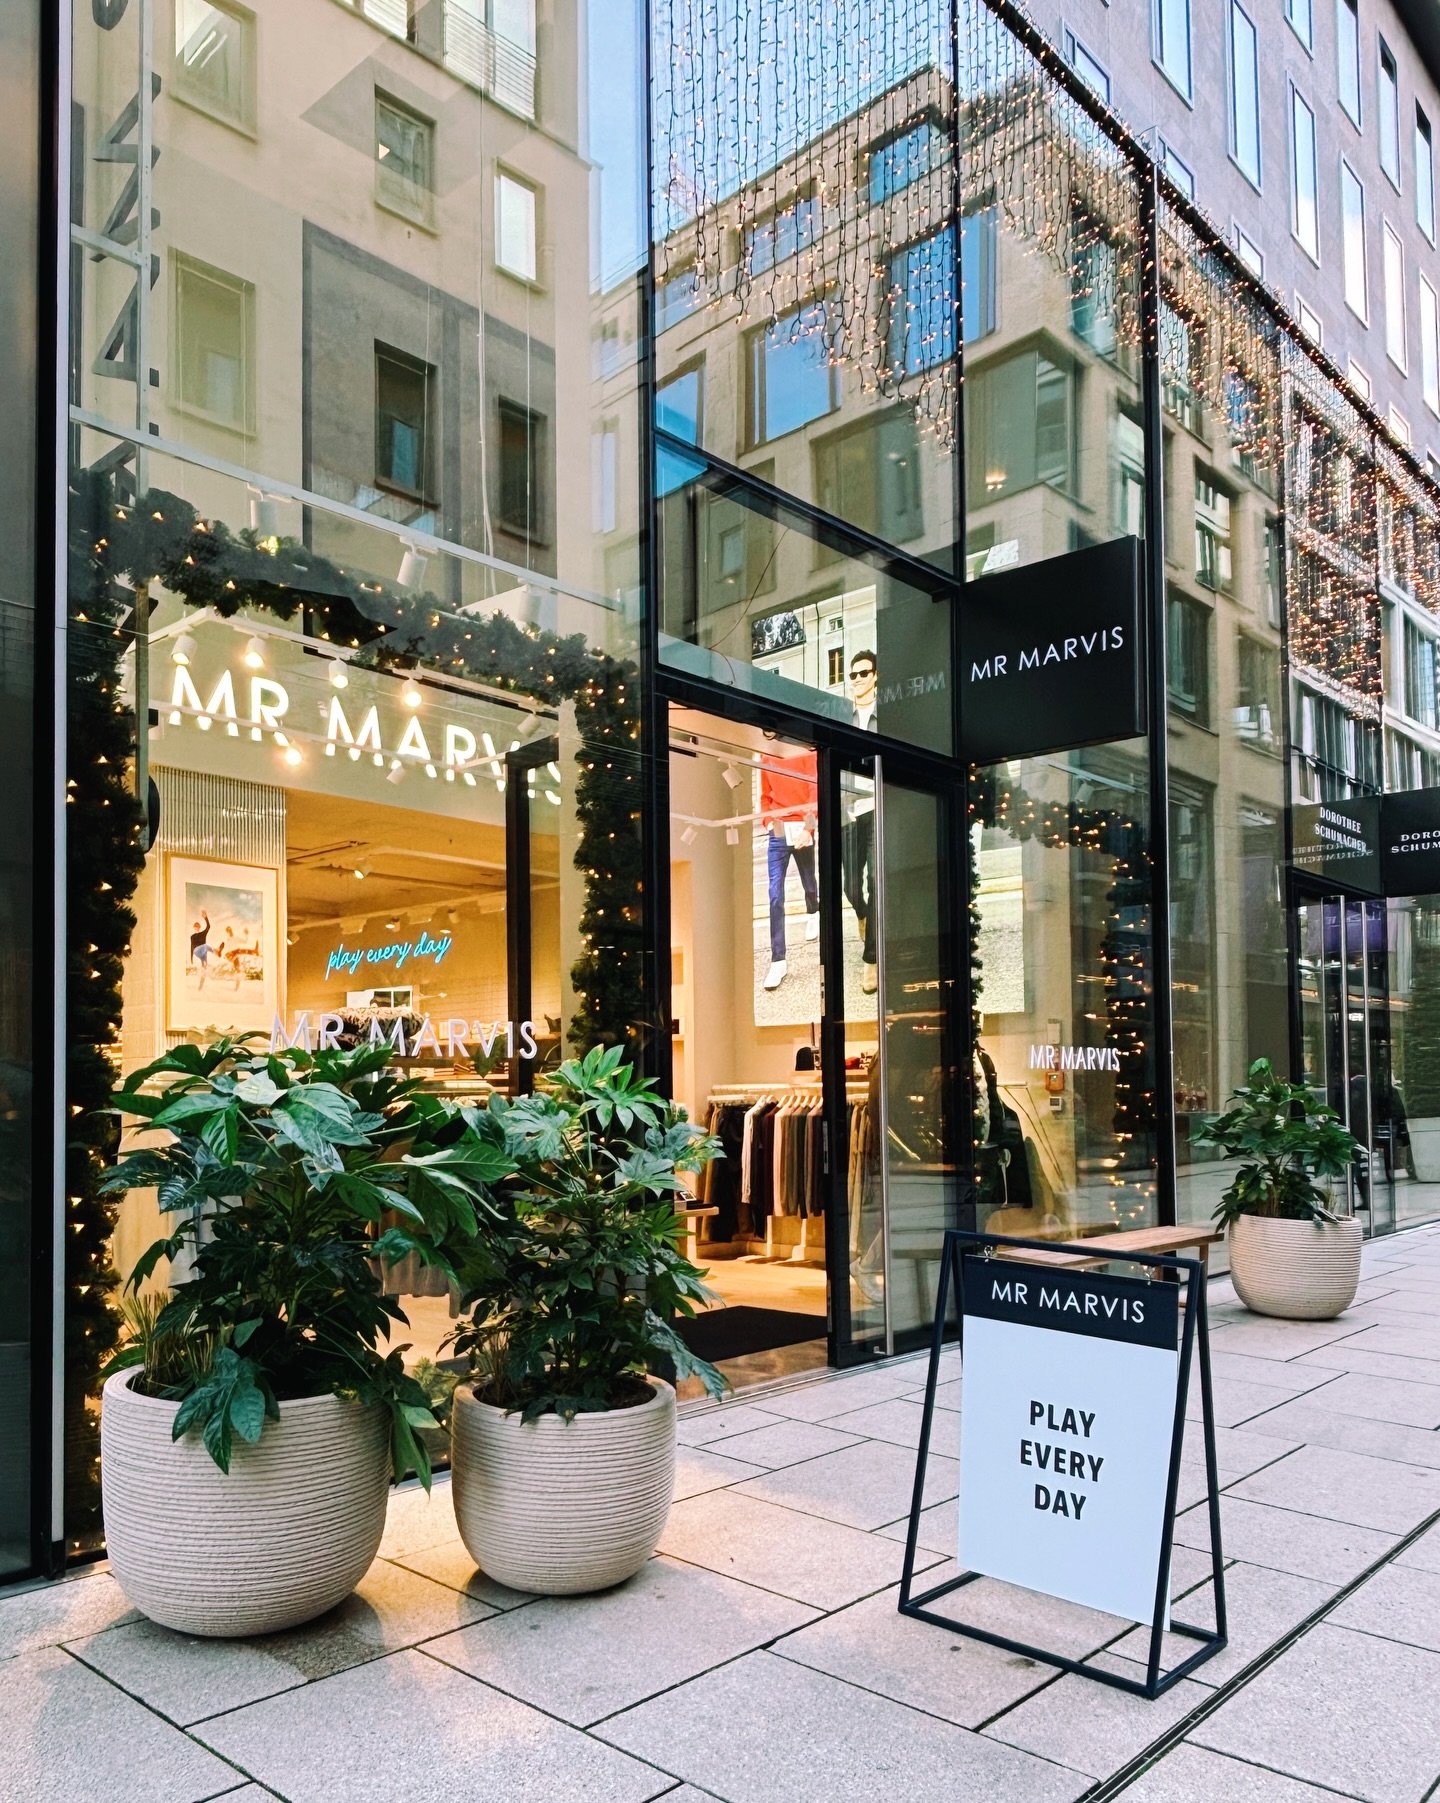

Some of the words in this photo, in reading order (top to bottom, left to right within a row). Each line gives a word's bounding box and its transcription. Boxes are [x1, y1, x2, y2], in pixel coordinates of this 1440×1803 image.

[971, 654, 1008, 682] MR
[1018, 625, 1125, 672] MARVIS
[168, 664, 290, 748] MR
[1313, 822, 1367, 852] SCHUMACHER
[1319, 806, 1362, 834] DOROTHEE
[324, 943, 364, 981] play
[366, 941, 413, 969] every
[413, 931, 452, 964] day
[269, 1012, 345, 1055] MR
[369, 1015, 539, 1060] MARVIS
[1030, 1044, 1056, 1070] MR
[1060, 1045, 1121, 1072] MARVIS
[991, 1279, 1029, 1305] MR
[1038, 1287, 1146, 1324] MARVIS
[1029, 1400, 1096, 1438] PLAY
[1019, 1438, 1104, 1483] EVERY
[1034, 1483, 1087, 1521] DAY
